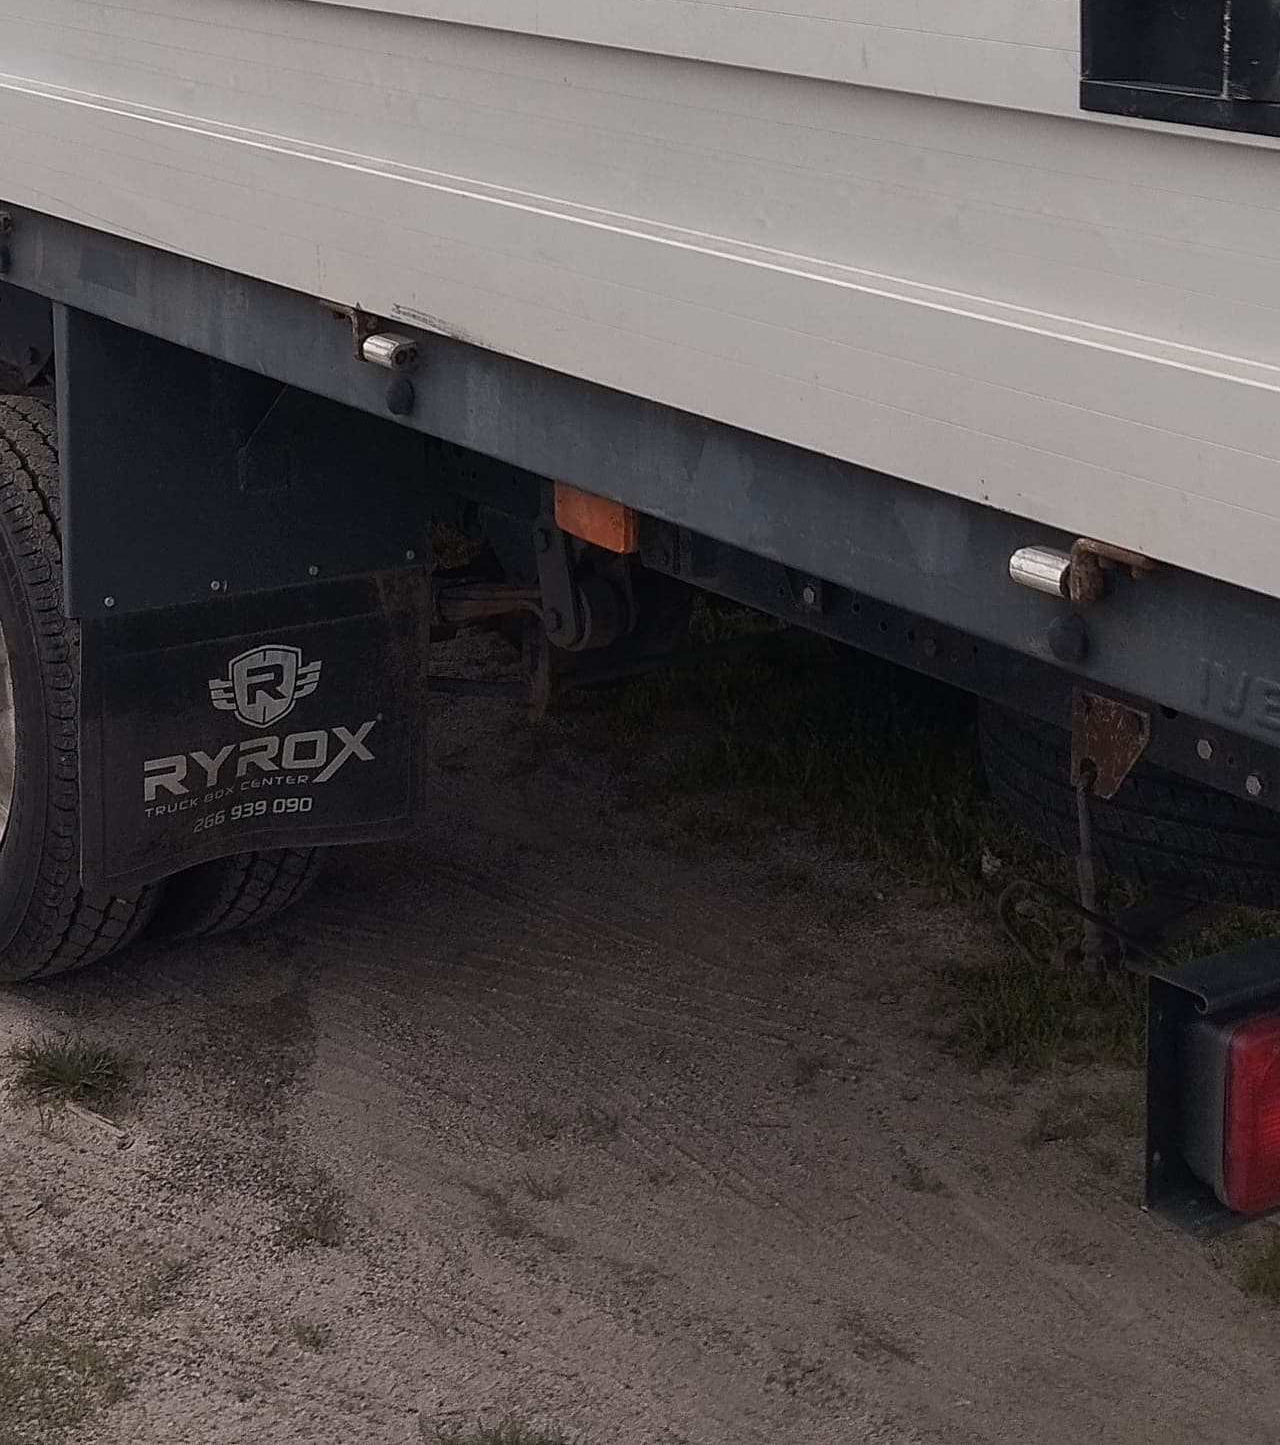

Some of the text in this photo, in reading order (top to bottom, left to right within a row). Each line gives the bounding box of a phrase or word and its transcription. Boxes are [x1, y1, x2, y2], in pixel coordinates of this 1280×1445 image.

[143, 720, 377, 802] RYROX
[144, 773, 310, 819] TRUCK BOX CENTER
[193, 796, 314, 833] 266 939 090
